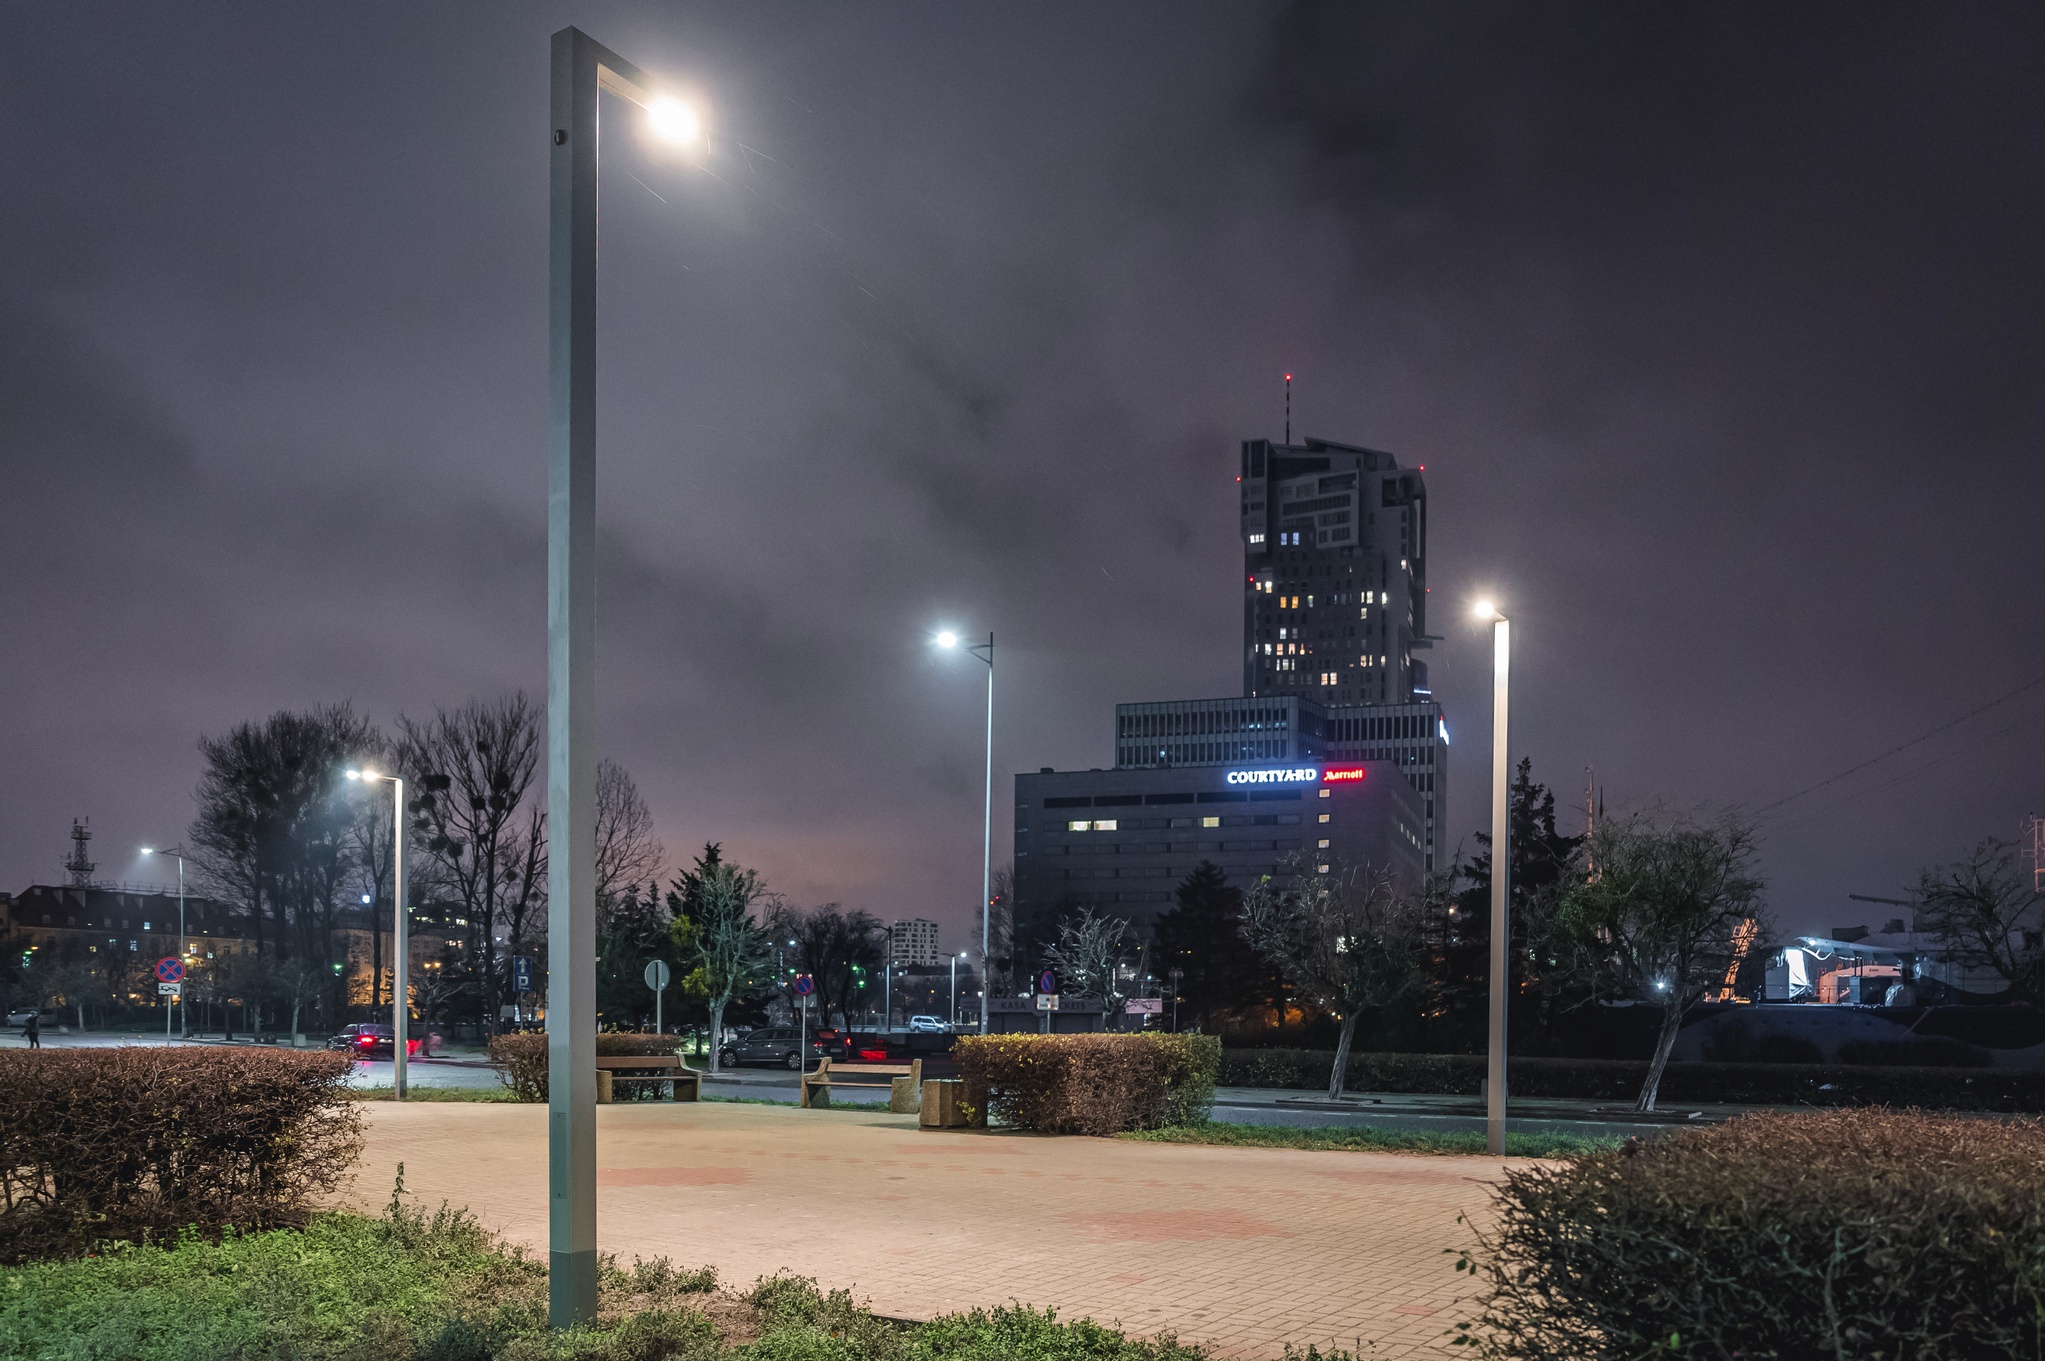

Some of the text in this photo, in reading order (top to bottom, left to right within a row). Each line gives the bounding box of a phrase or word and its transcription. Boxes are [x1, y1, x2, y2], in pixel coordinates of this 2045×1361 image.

[1227, 768, 1363, 784] COURTYARD Marriott
[518, 975, 529, 989] P
[1001, 1001, 1026, 1009] KASA
[1059, 1001, 1086, 1009] CKETS
